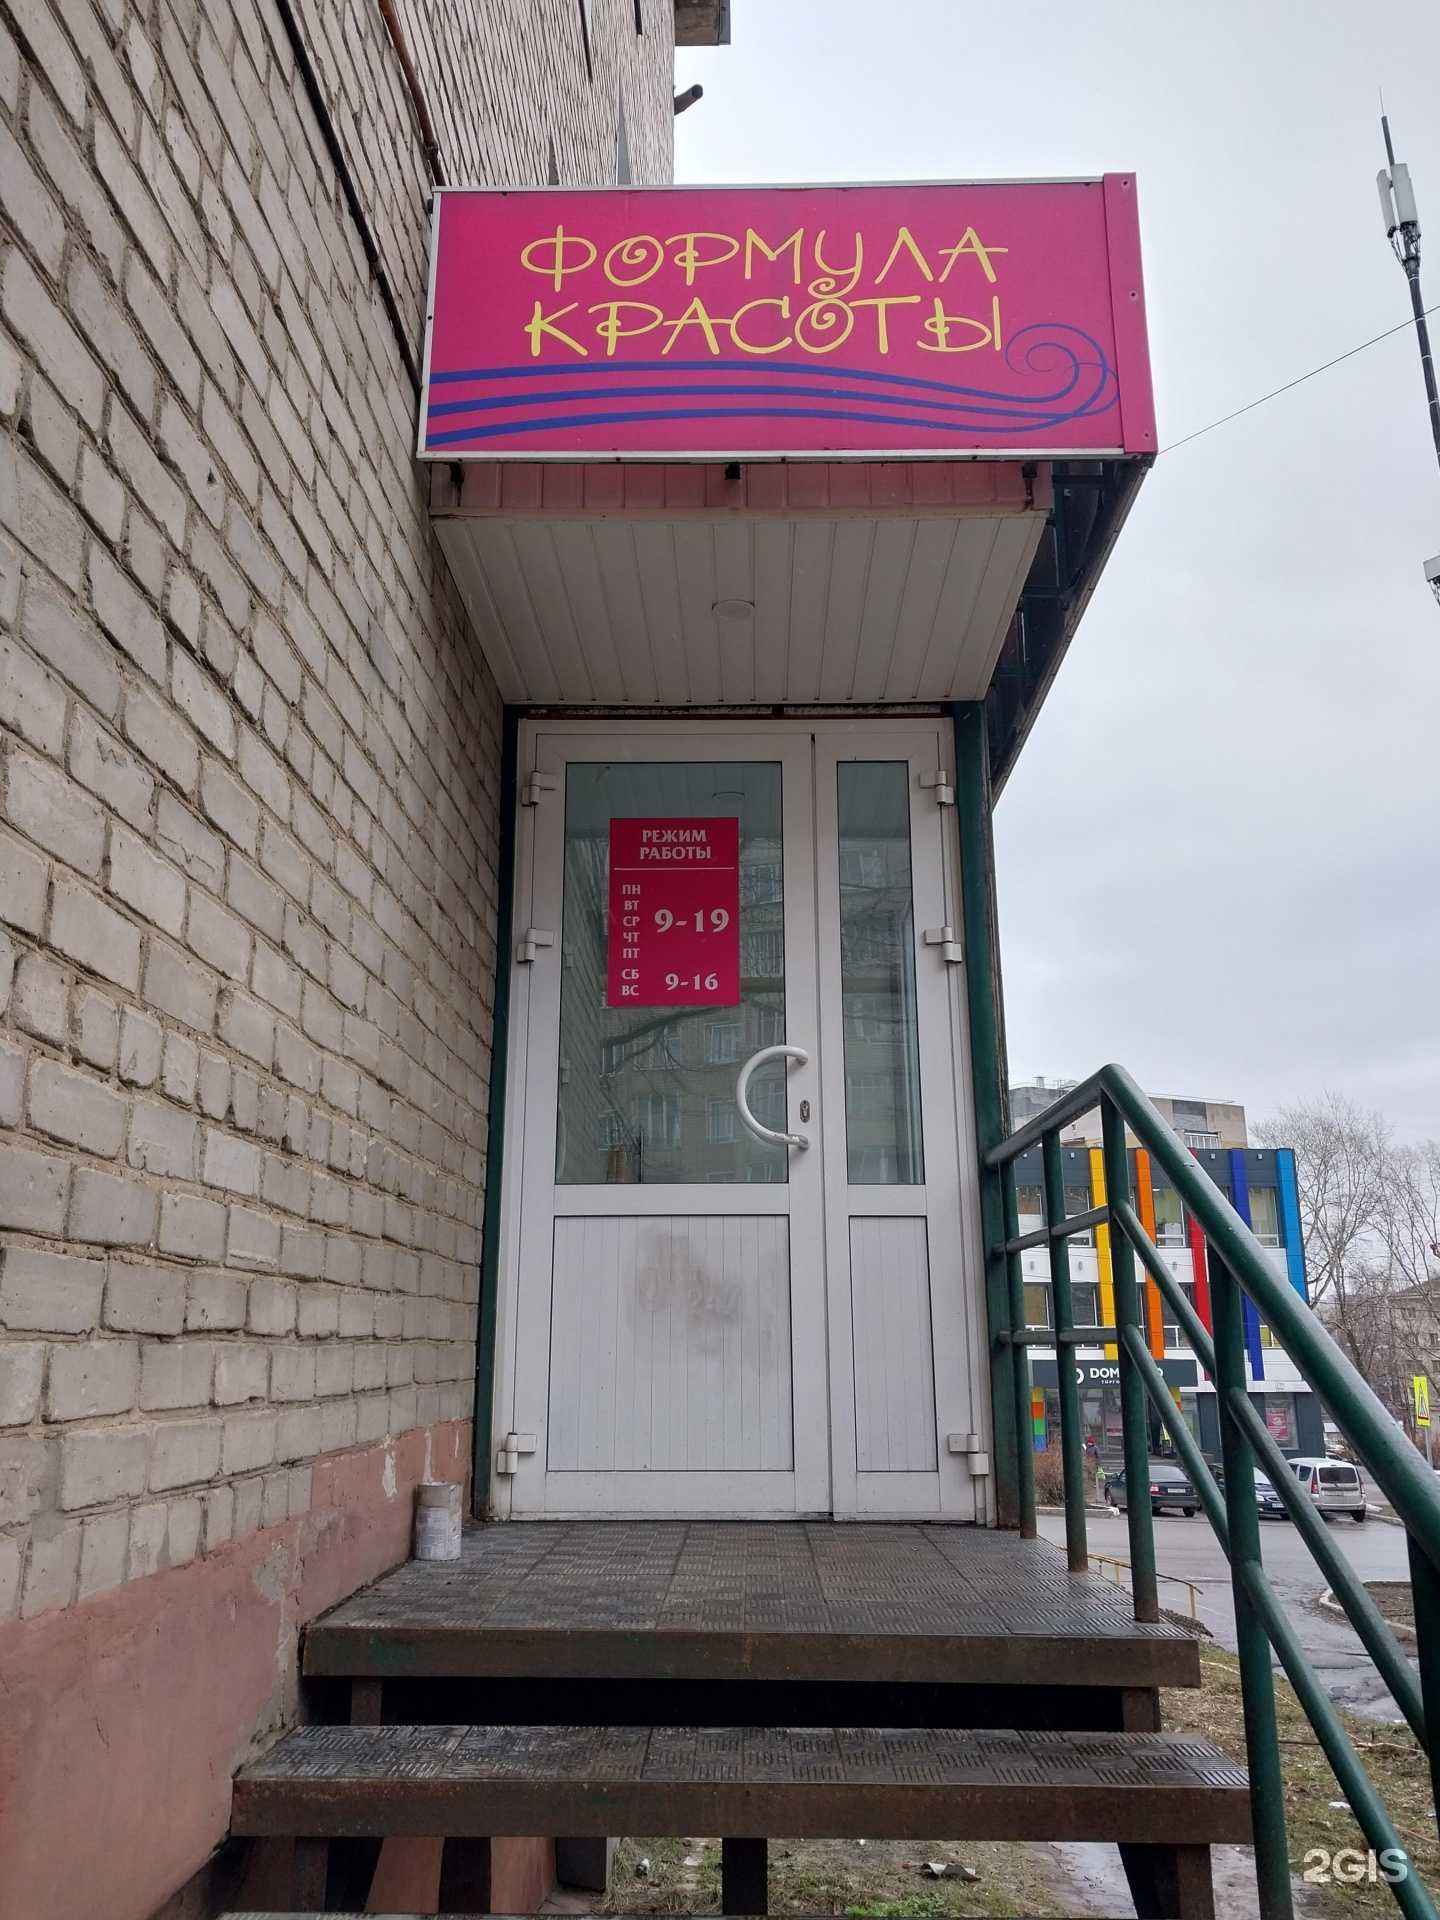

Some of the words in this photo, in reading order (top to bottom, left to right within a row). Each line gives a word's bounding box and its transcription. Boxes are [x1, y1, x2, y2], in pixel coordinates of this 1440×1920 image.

[520, 224, 1009, 298] ФОРМУЛА
[524, 295, 1003, 356] КРАСОТЫ
[642, 829, 707, 843] РЕЖИМ
[639, 846, 711, 860] РАБОТЫ
[622, 884, 641, 895] ПН
[624, 900, 640, 911] ВТ
[623, 916, 640, 927] СР
[654, 908, 730, 933] 9-19
[623, 932, 640, 943] ЧТ
[622, 948, 640, 959] ПТ
[621, 968, 640, 979] СБ
[665, 972, 720, 991] 9-16
[621, 985, 640, 996] ВС
